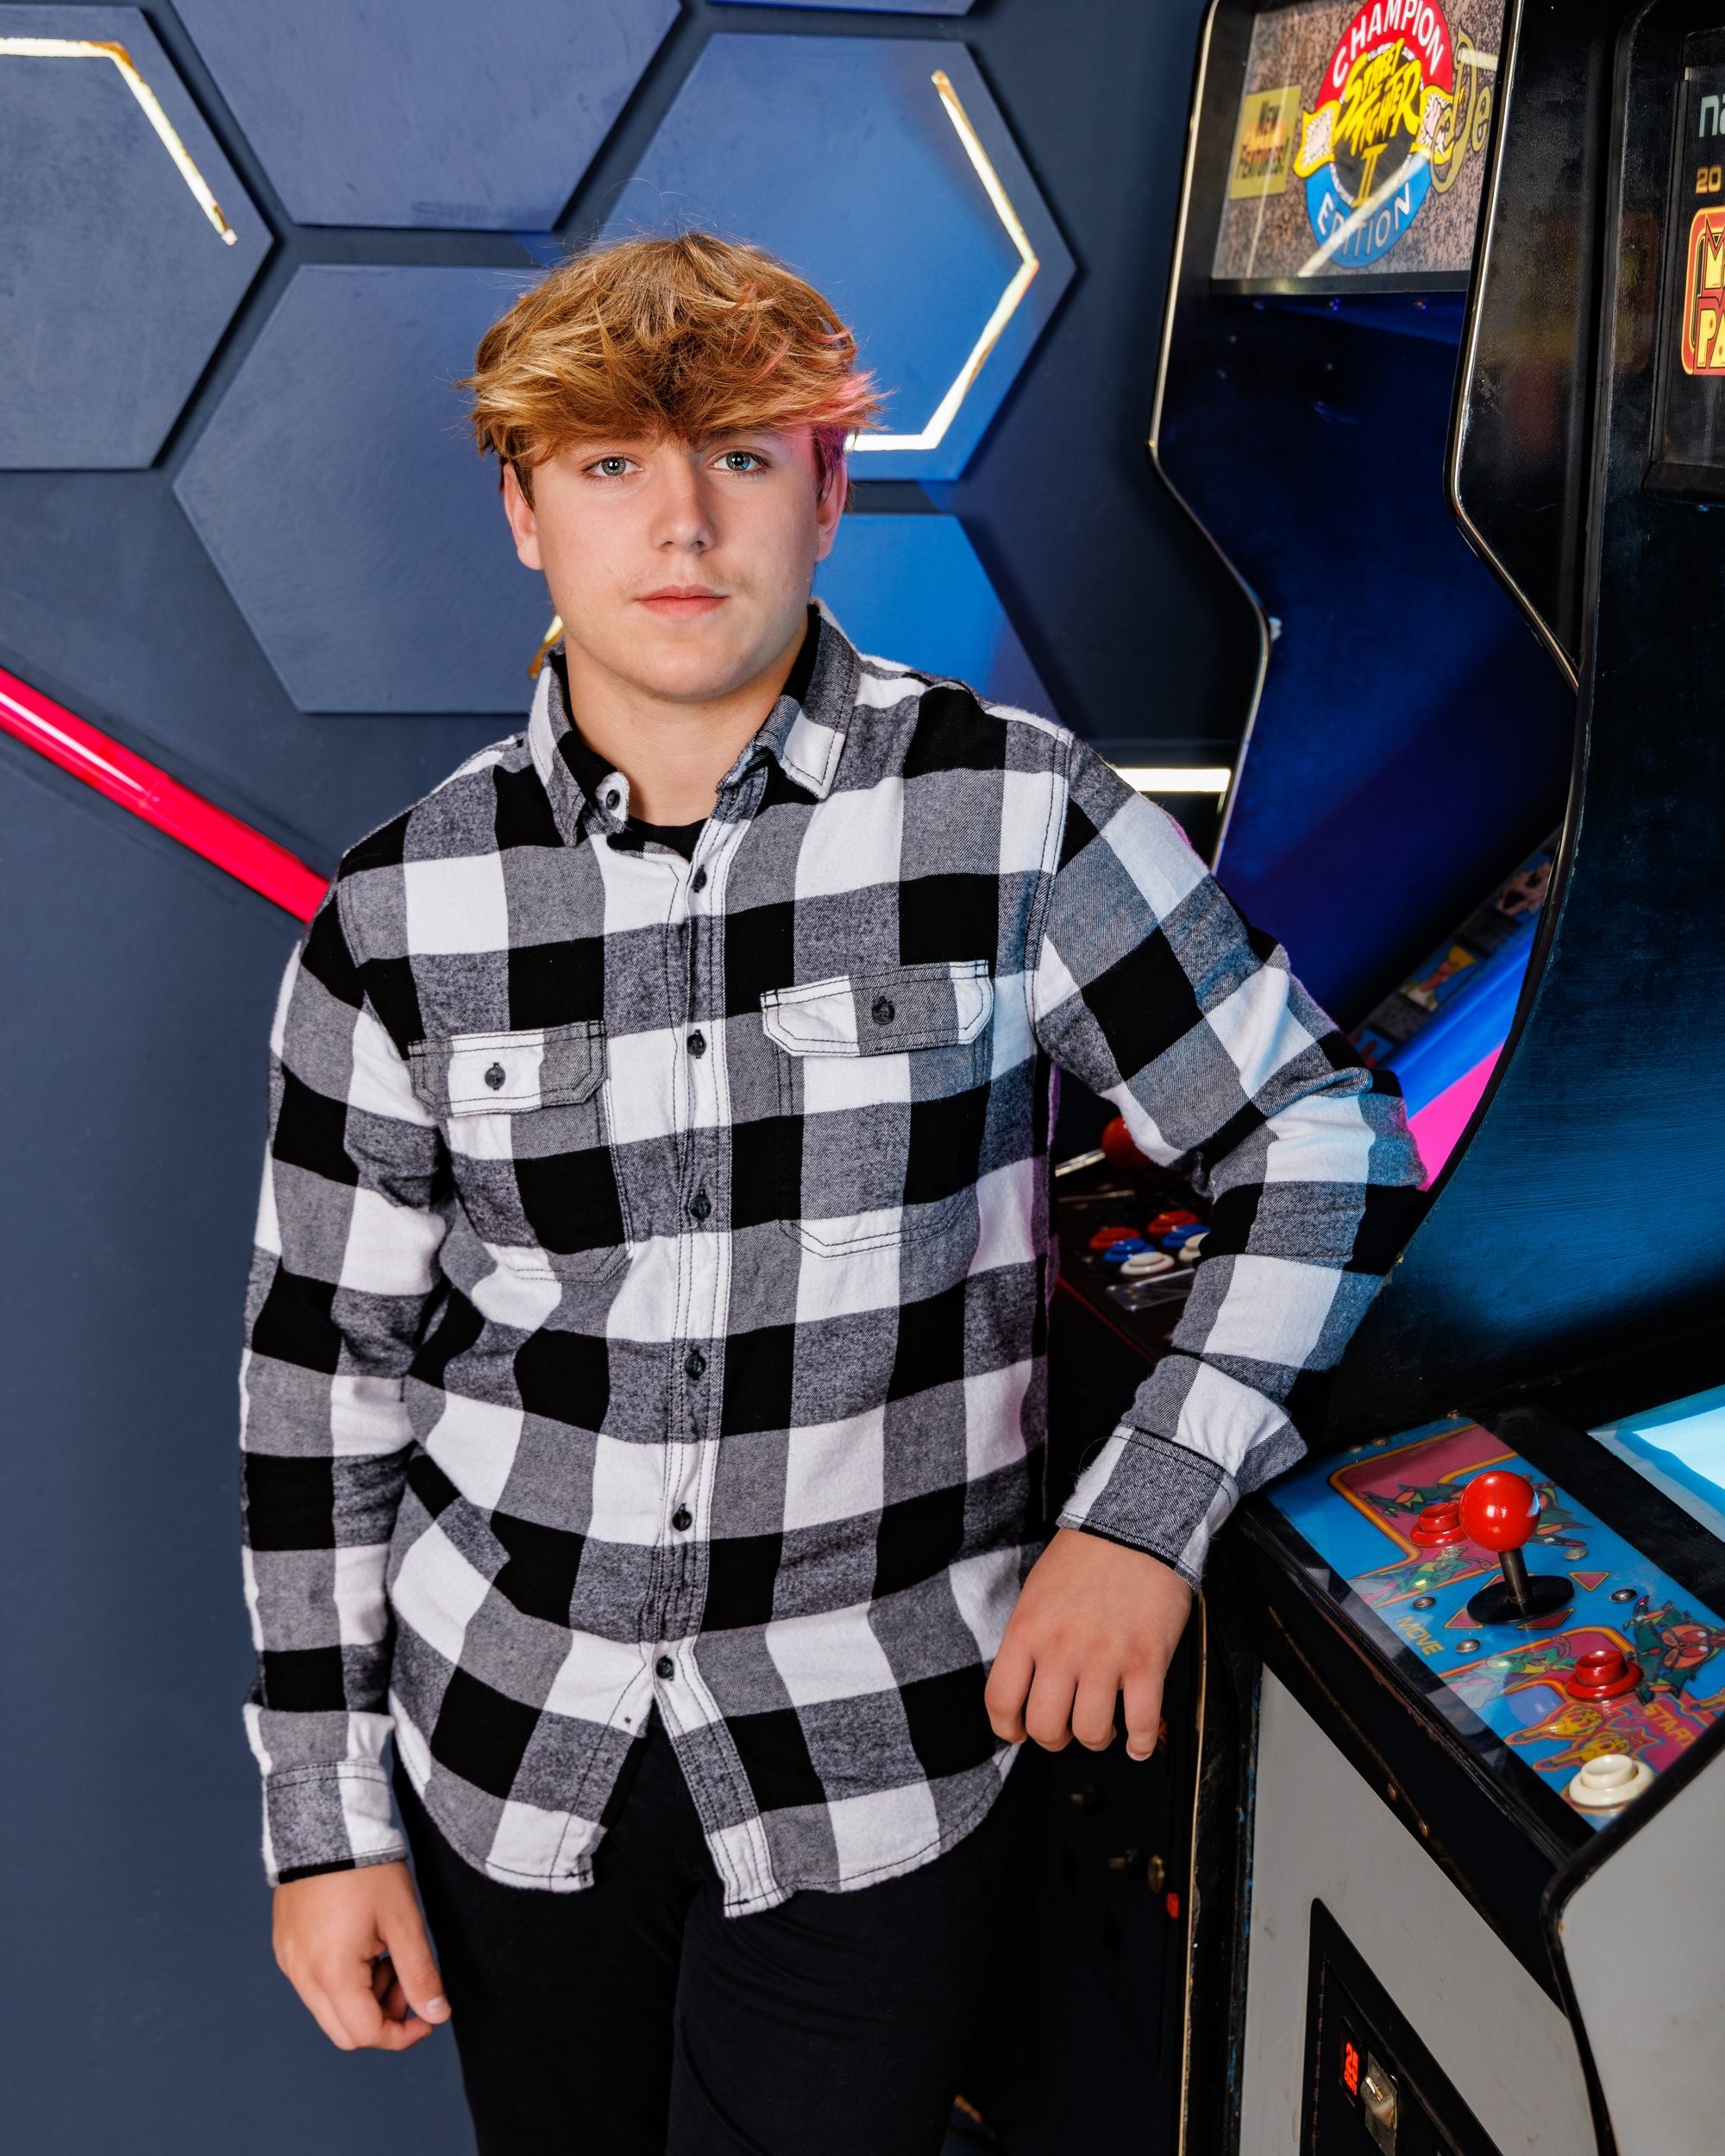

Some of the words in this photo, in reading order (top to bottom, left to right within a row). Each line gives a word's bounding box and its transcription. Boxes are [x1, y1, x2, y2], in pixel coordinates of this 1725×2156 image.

[1333, 0, 1444, 88] CHAMPION
[1341, 59, 1423, 157] FIGHTER
[1695, 165, 1722, 194] 20
[1394, 1616, 1445, 1656] MOVE
